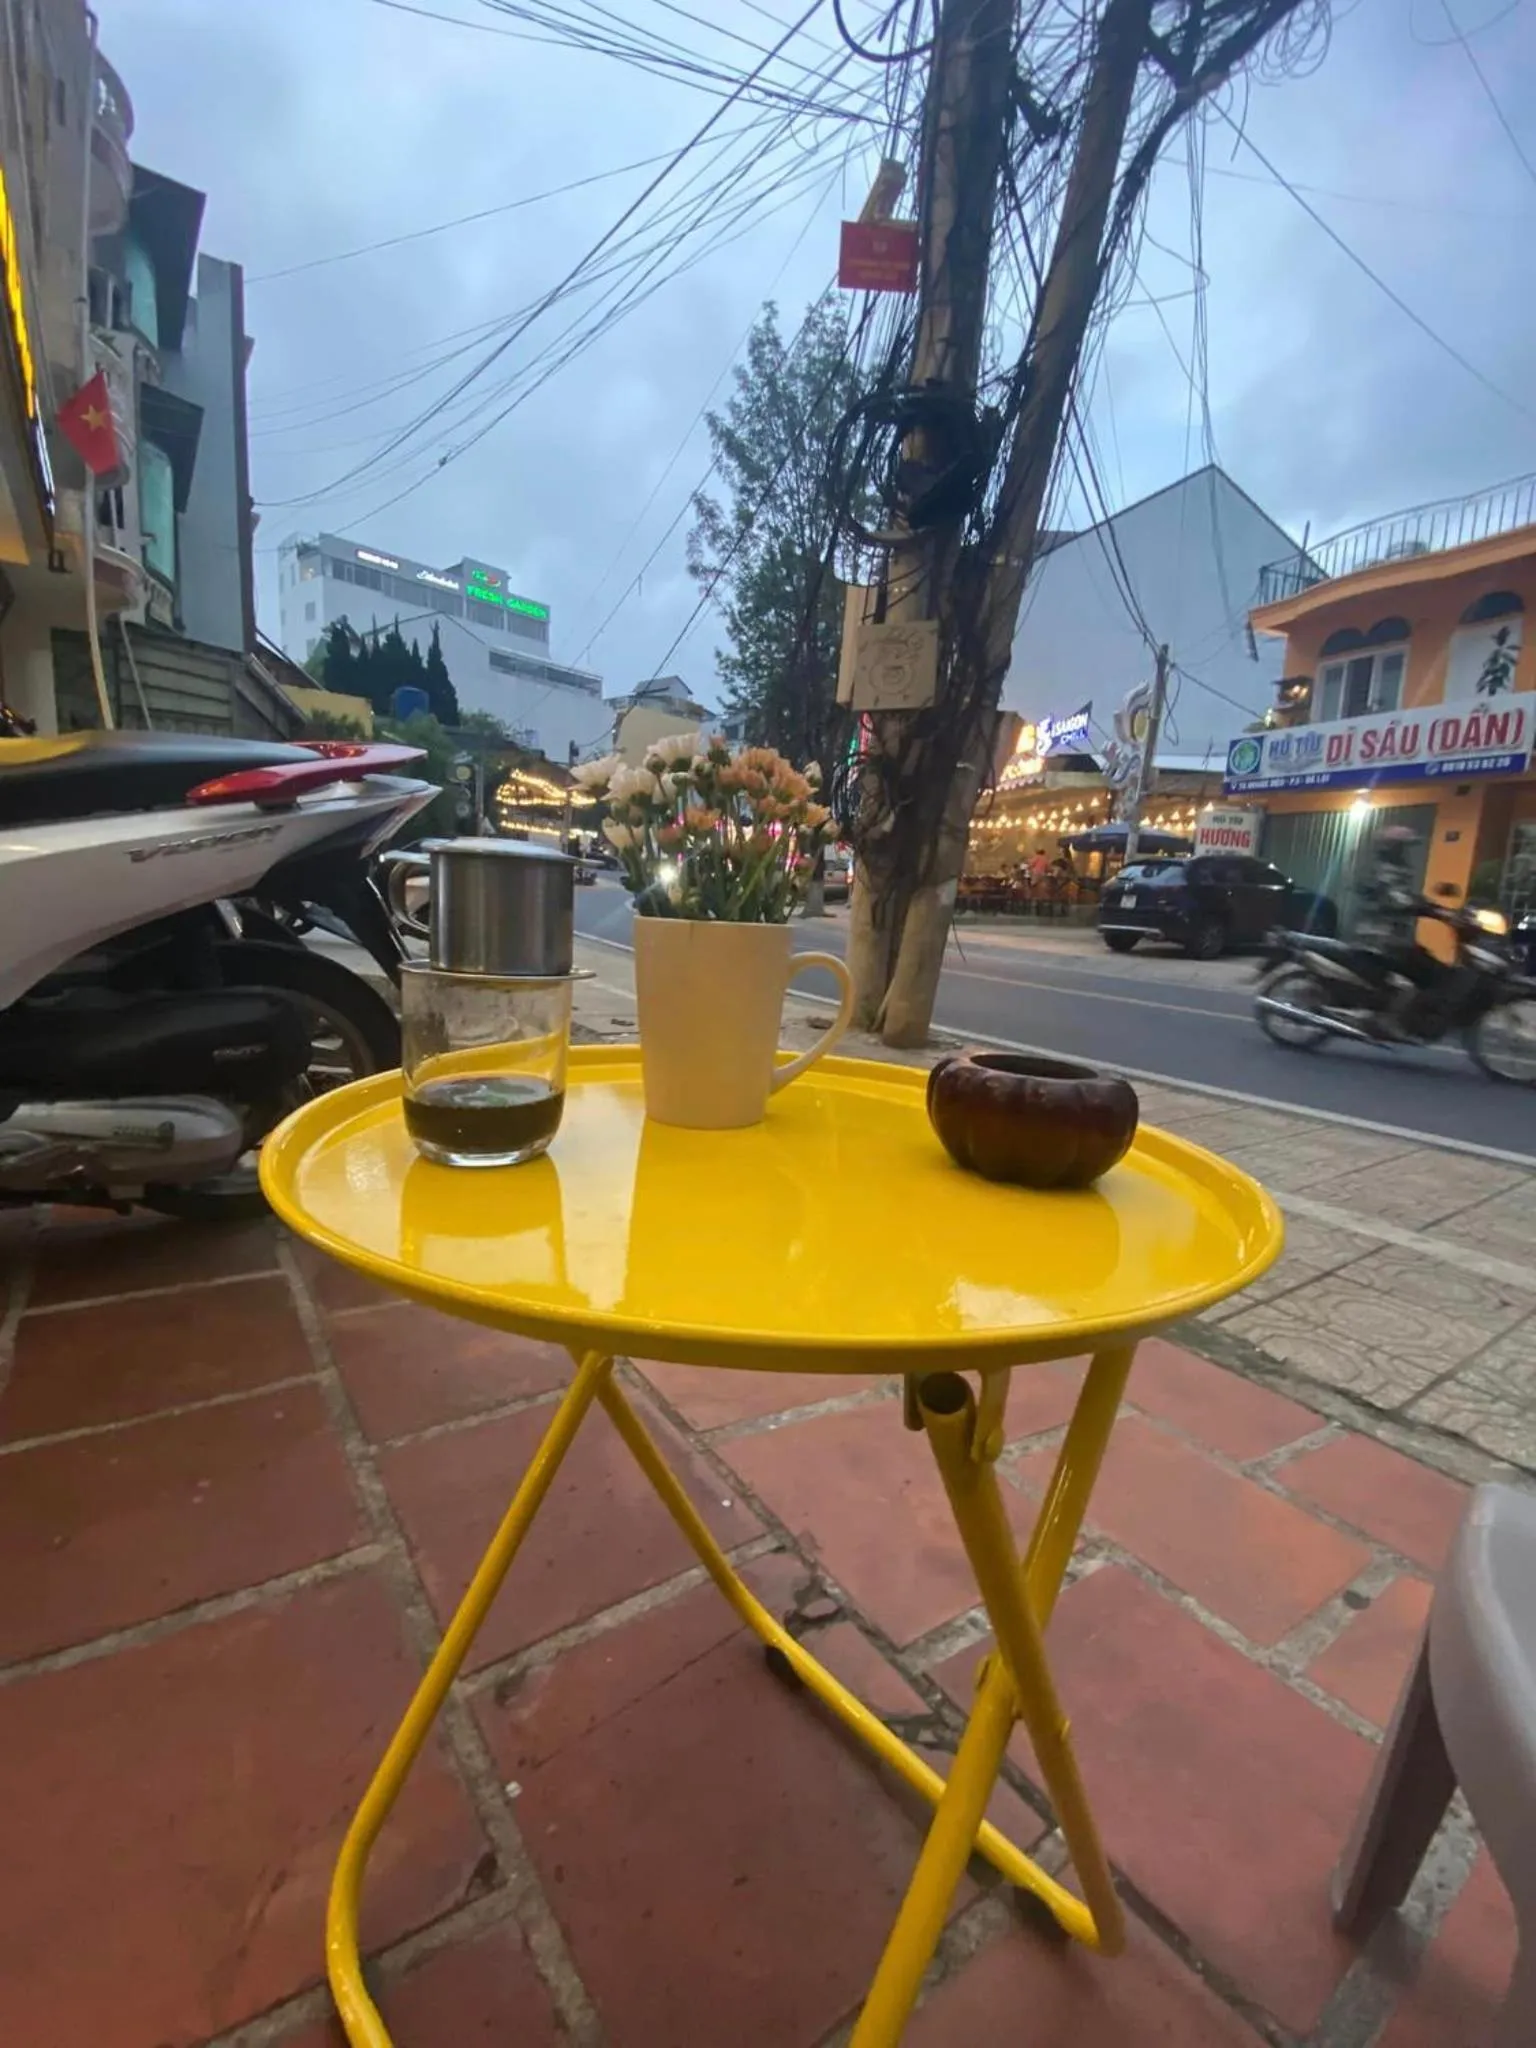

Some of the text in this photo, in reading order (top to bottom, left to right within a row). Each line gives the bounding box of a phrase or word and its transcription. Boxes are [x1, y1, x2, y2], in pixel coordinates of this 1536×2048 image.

[466, 584, 547, 619] FRESH GARDEN
[1360, 719, 1420, 759] SÁU
